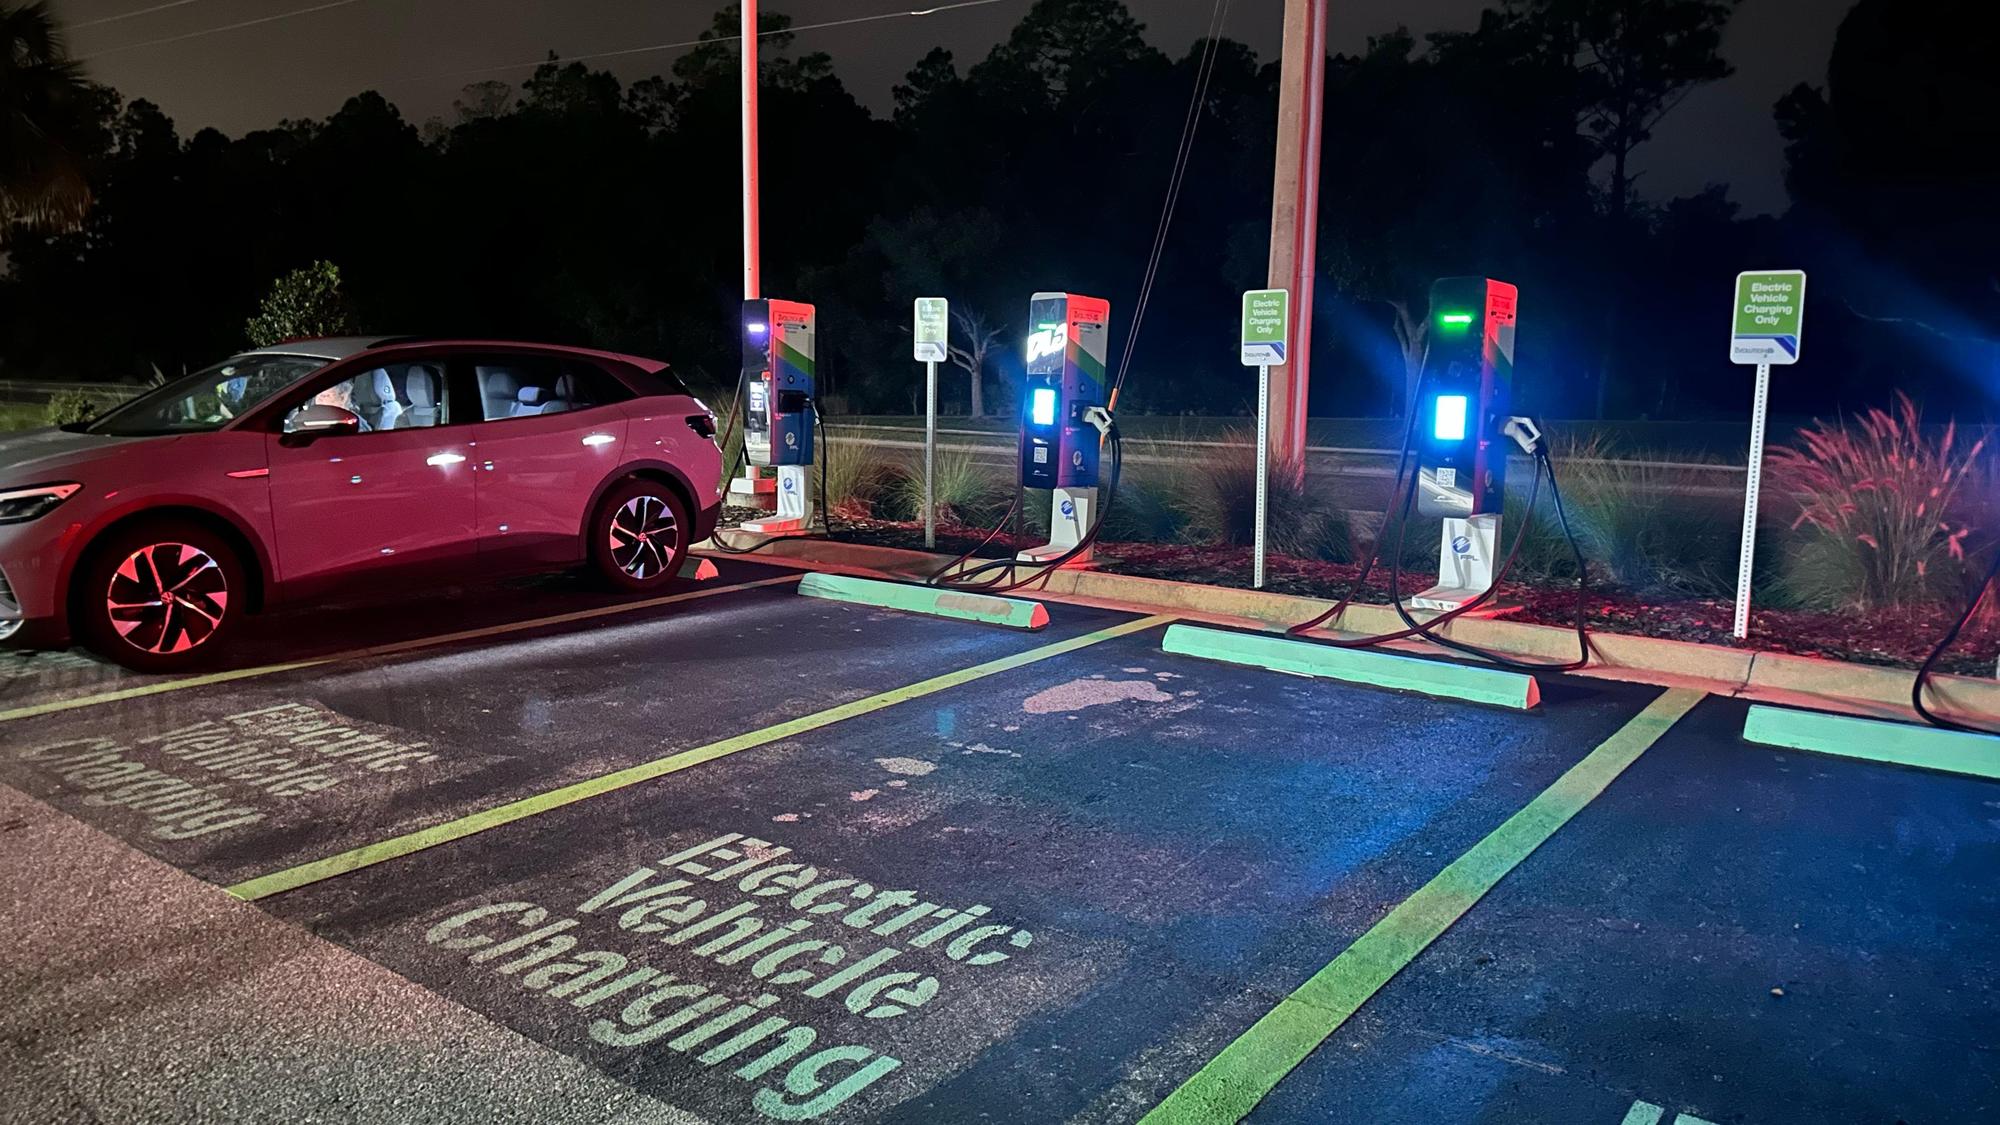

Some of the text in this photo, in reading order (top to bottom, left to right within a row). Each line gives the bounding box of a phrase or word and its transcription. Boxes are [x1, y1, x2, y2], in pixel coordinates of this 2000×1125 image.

[1750, 294, 1789, 302] Vehicle
[1751, 283, 1792, 292] Electric
[1249, 318, 1281, 326] Charging
[1743, 304, 1793, 315] Charging
[1755, 315, 1780, 326] Only
[1257, 327, 1273, 335] Only
[224, 702, 440, 773] Electric
[138, 720, 340, 797] Vehicle
[18, 736, 267, 840] Charging
[659, 832, 1033, 966] Electric
[577, 868, 940, 1018] Vehicle
[425, 902, 902, 1121] Charging
